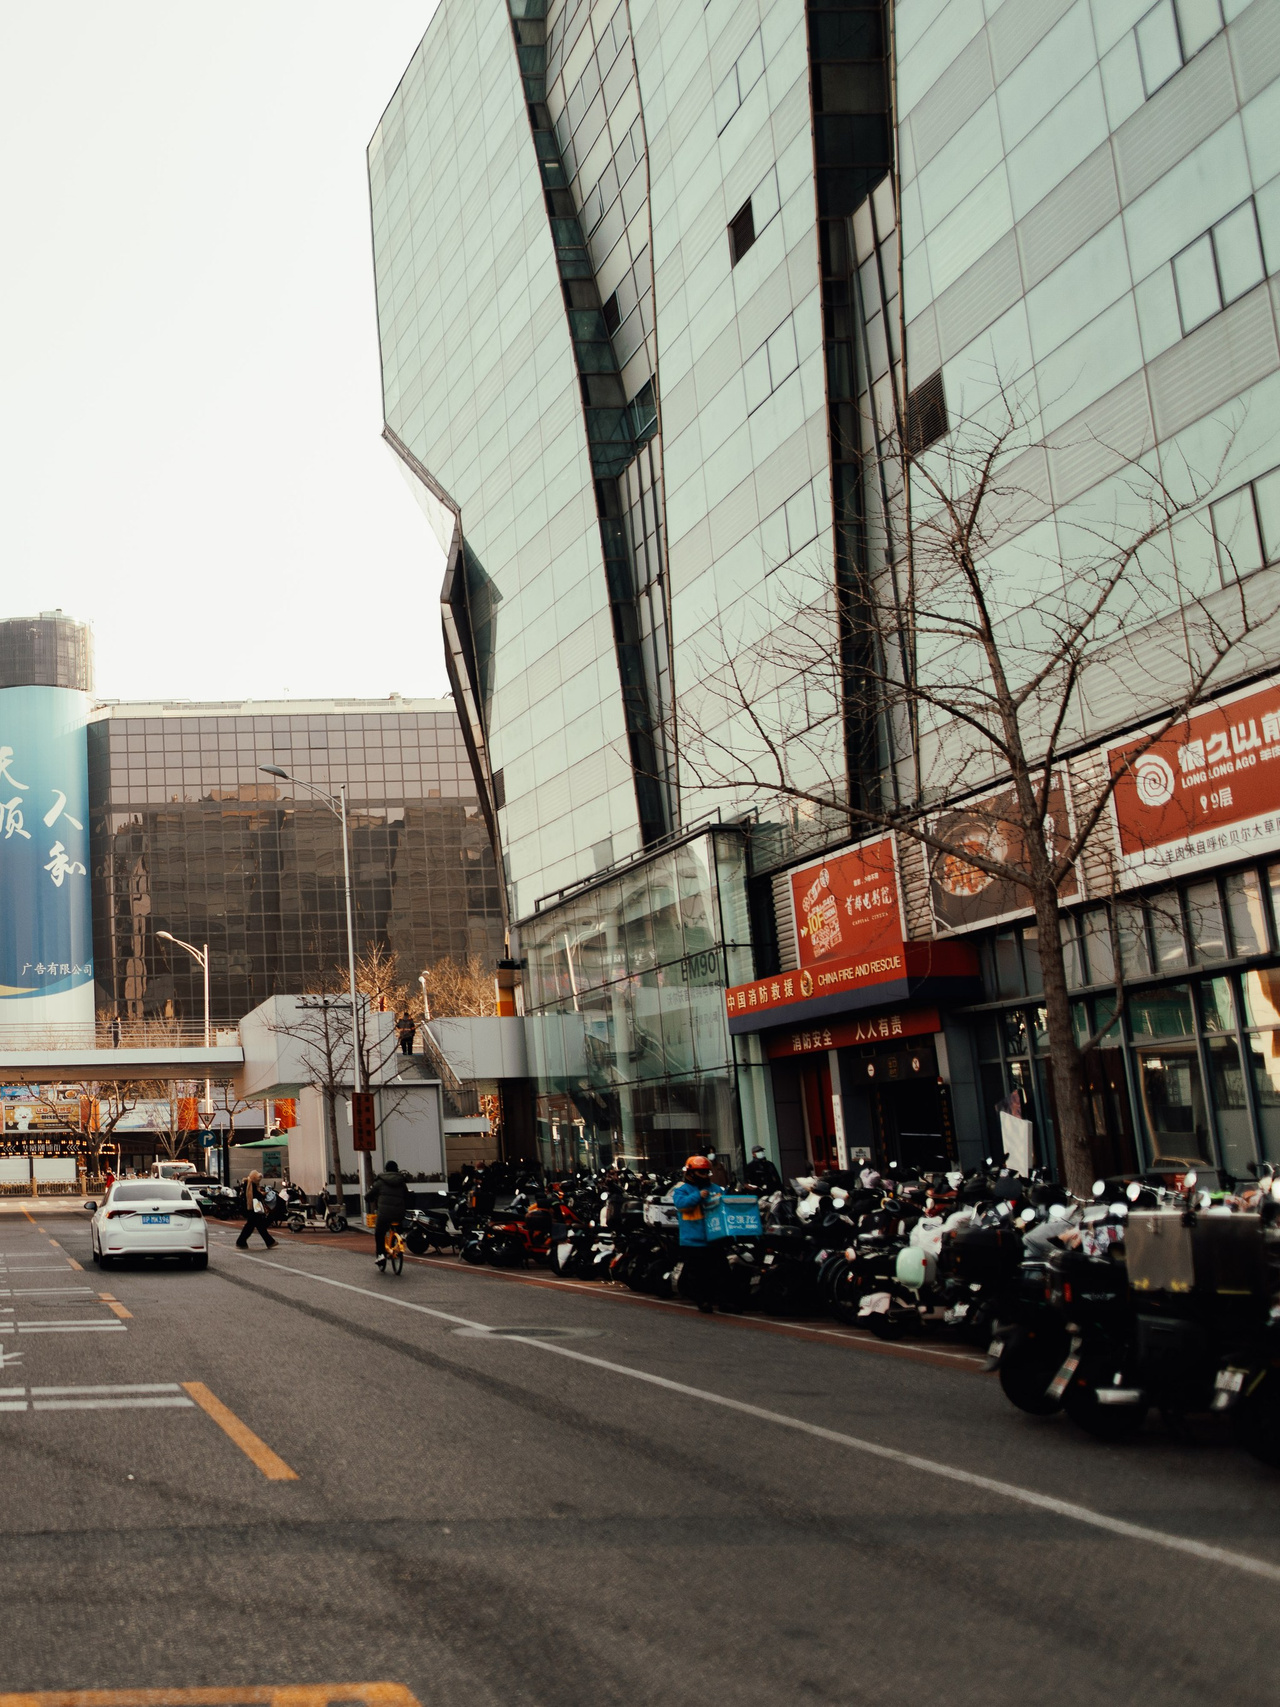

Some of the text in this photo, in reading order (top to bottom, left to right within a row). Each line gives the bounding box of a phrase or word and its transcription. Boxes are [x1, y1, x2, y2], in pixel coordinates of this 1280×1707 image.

[1177, 709, 1280, 773] 很久以前
[1181, 754, 1257, 789] LONG LONG AGO
[1210, 787, 1233, 808] 9层
[43, 788, 87, 887] 人和
[21, 962, 93, 977] 广告有限公司
[817, 955, 902, 988] CHINA FIRE AND RESCUE
[727, 978, 795, 1012] 中国消防救援
[792, 1015, 903, 1051] 消防安全 人人有责
